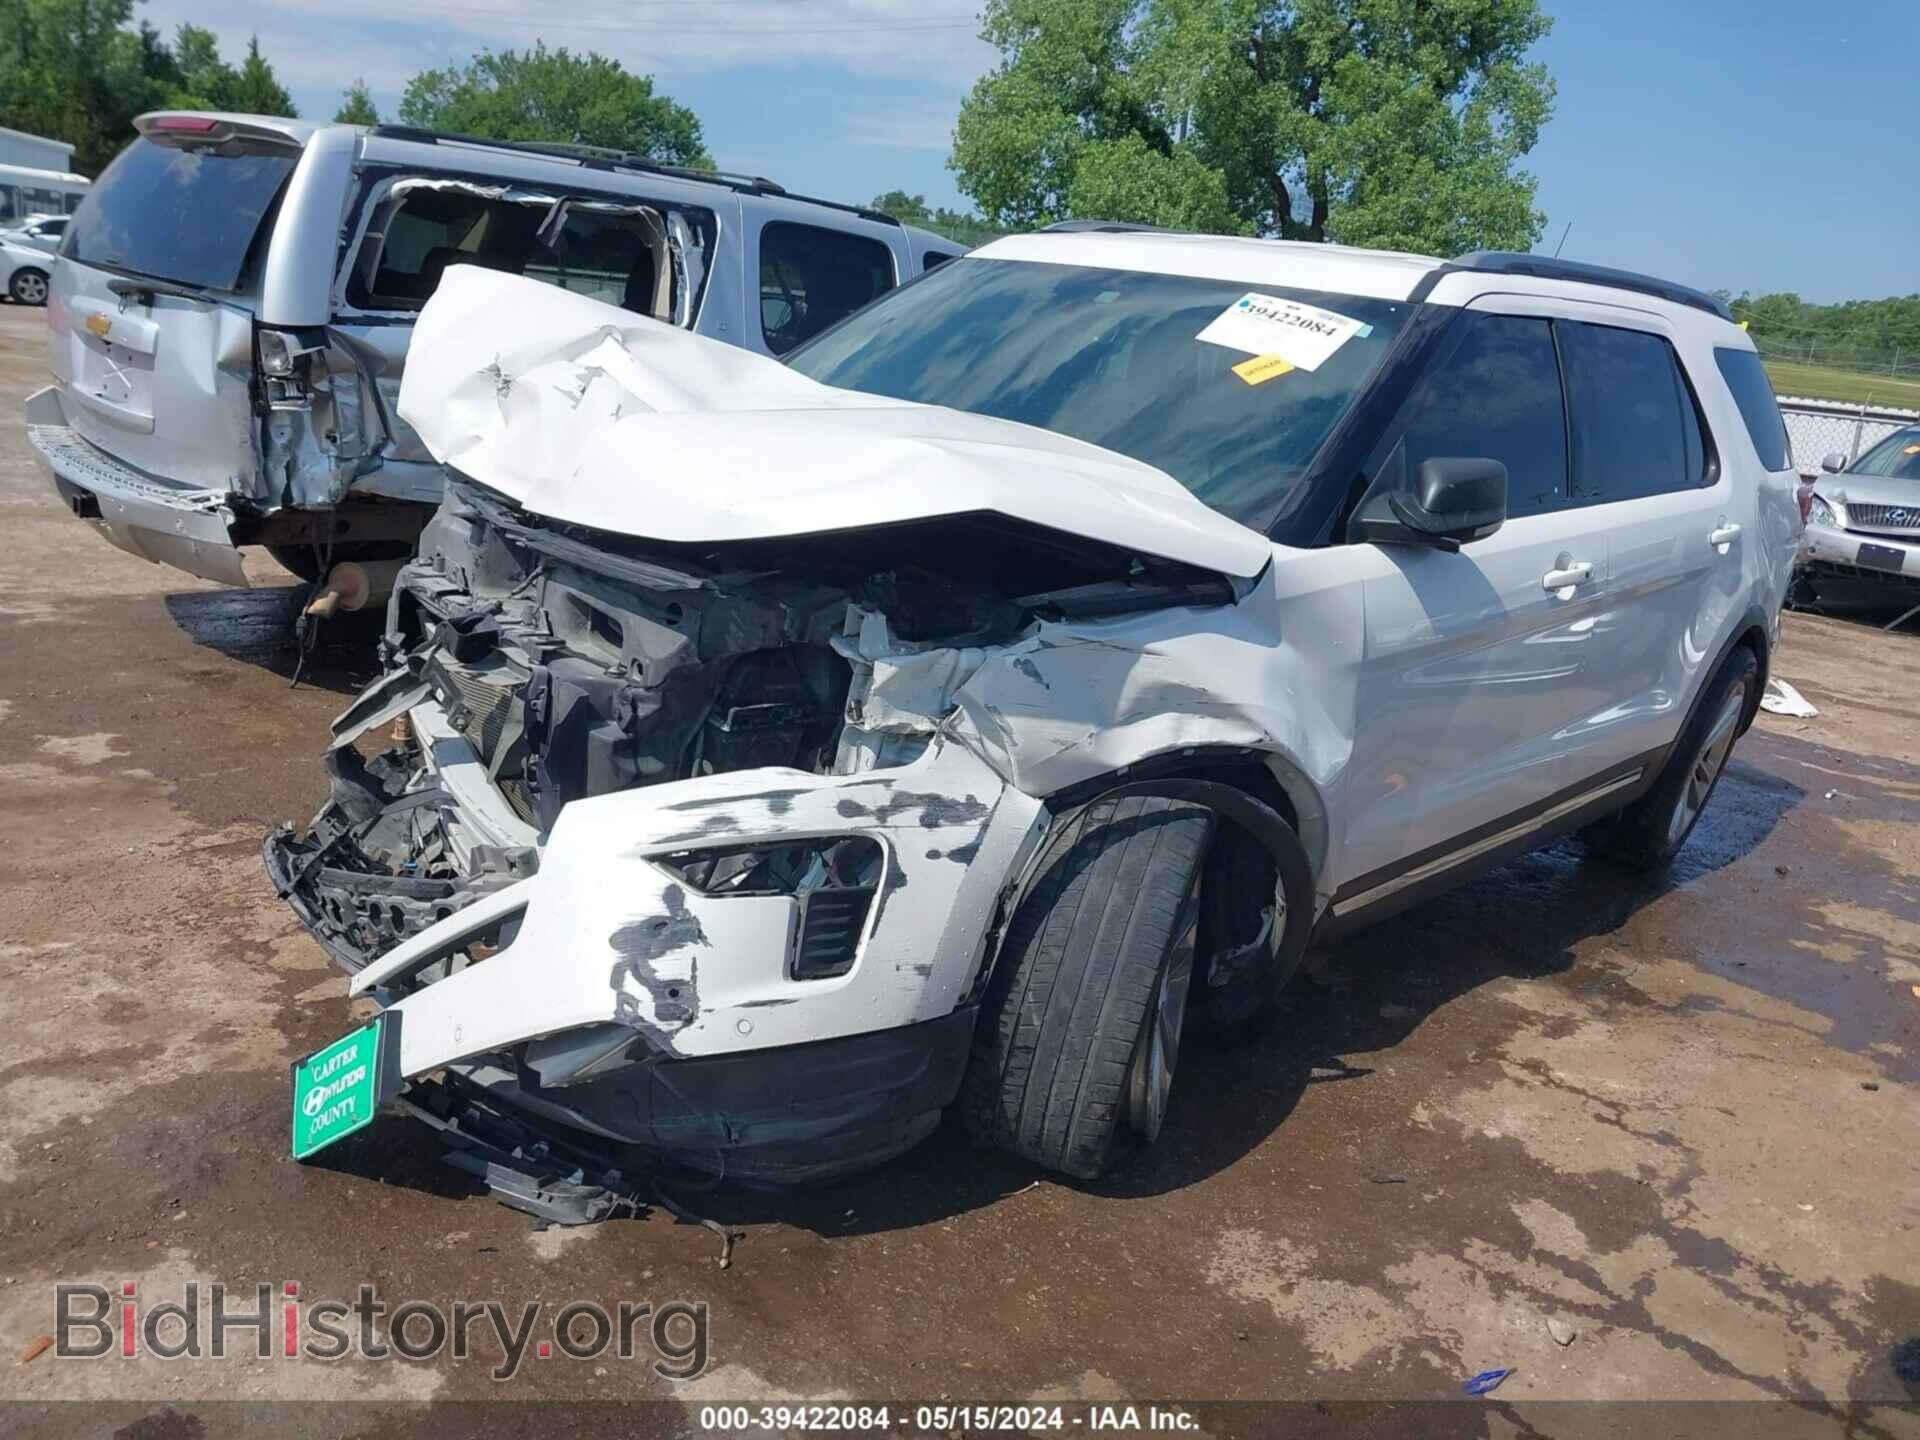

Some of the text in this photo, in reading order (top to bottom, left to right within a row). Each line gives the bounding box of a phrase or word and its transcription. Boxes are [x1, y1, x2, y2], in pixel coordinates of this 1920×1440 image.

[1242, 304, 1337, 337] 39422084
[313, 1044, 358, 1082] CARTER
[310, 1096, 356, 1134] COUNTY
